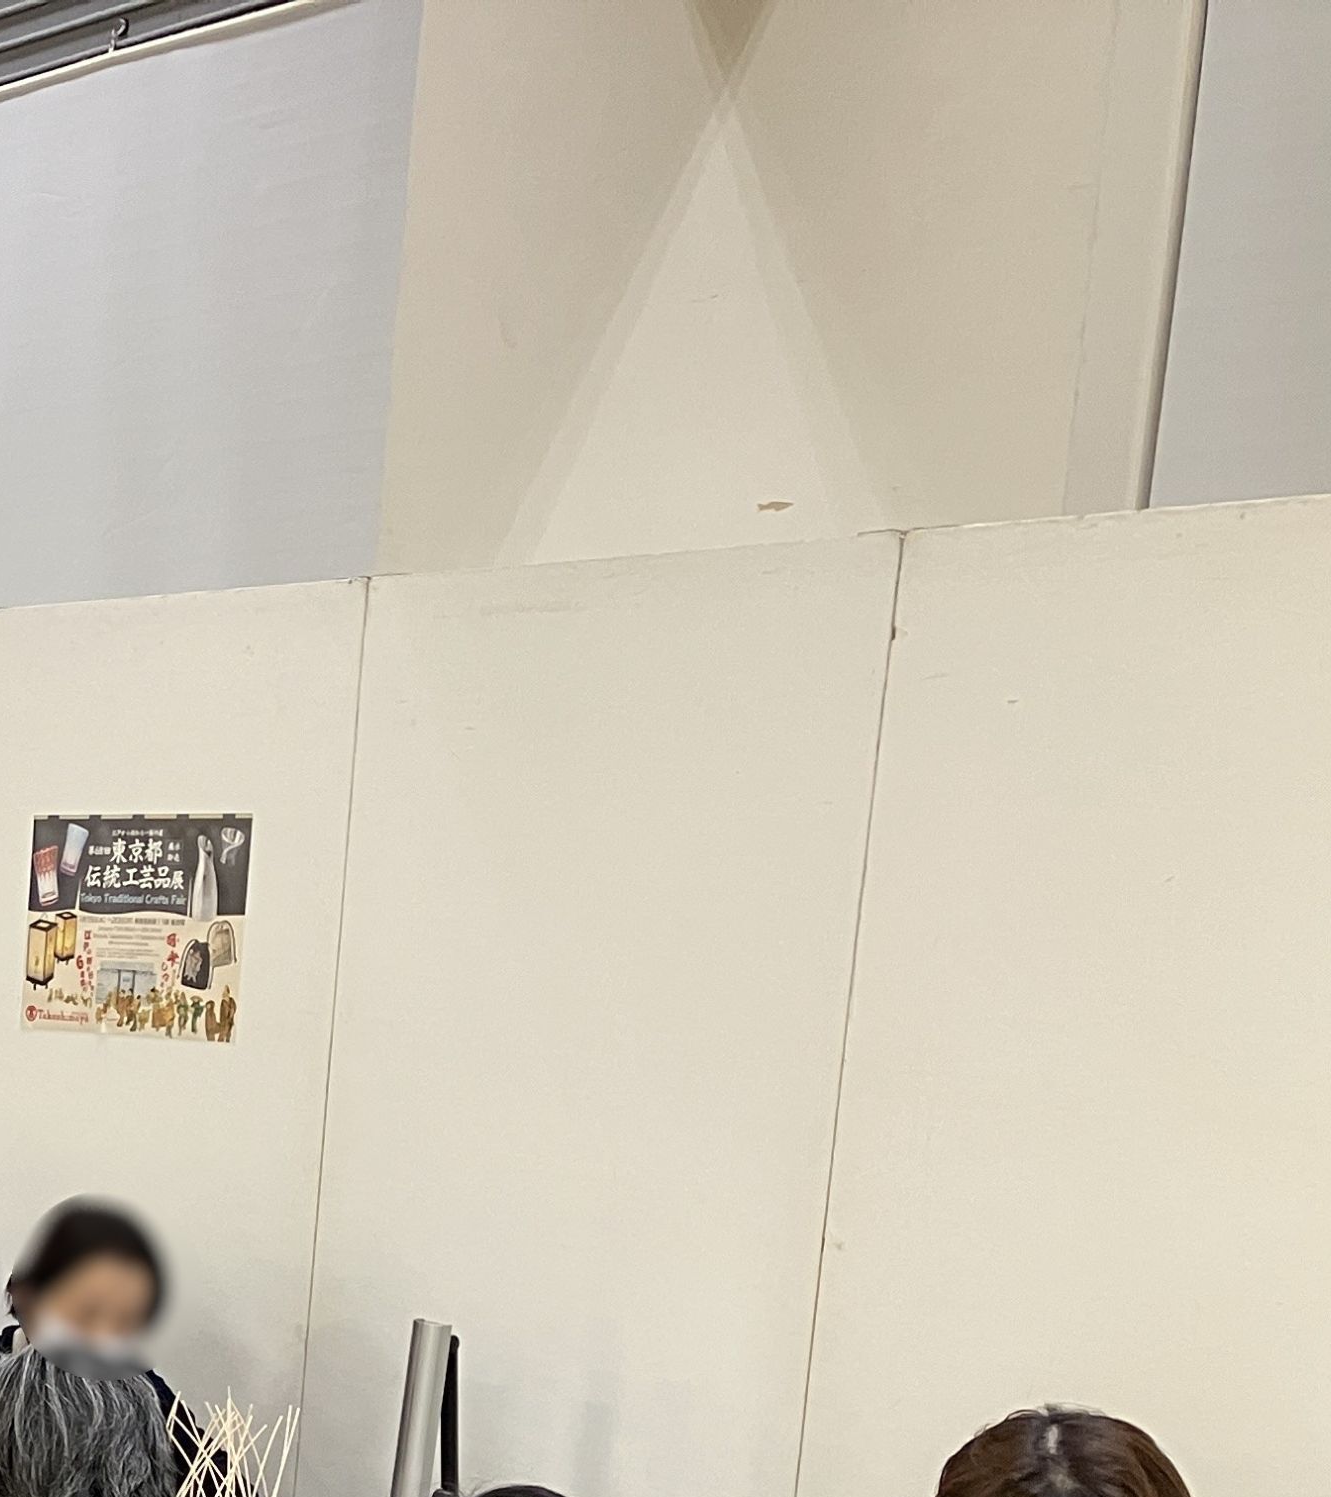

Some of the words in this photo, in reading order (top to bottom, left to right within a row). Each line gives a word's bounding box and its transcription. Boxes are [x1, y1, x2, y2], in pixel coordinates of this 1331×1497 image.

[110, 838, 163, 864] 東京都
[84, 865, 184, 890] 伝統工芸品展
[80, 893, 102, 904] Tokyo
[104, 893, 144, 904] Traditional
[170, 894, 187, 905] Fair
